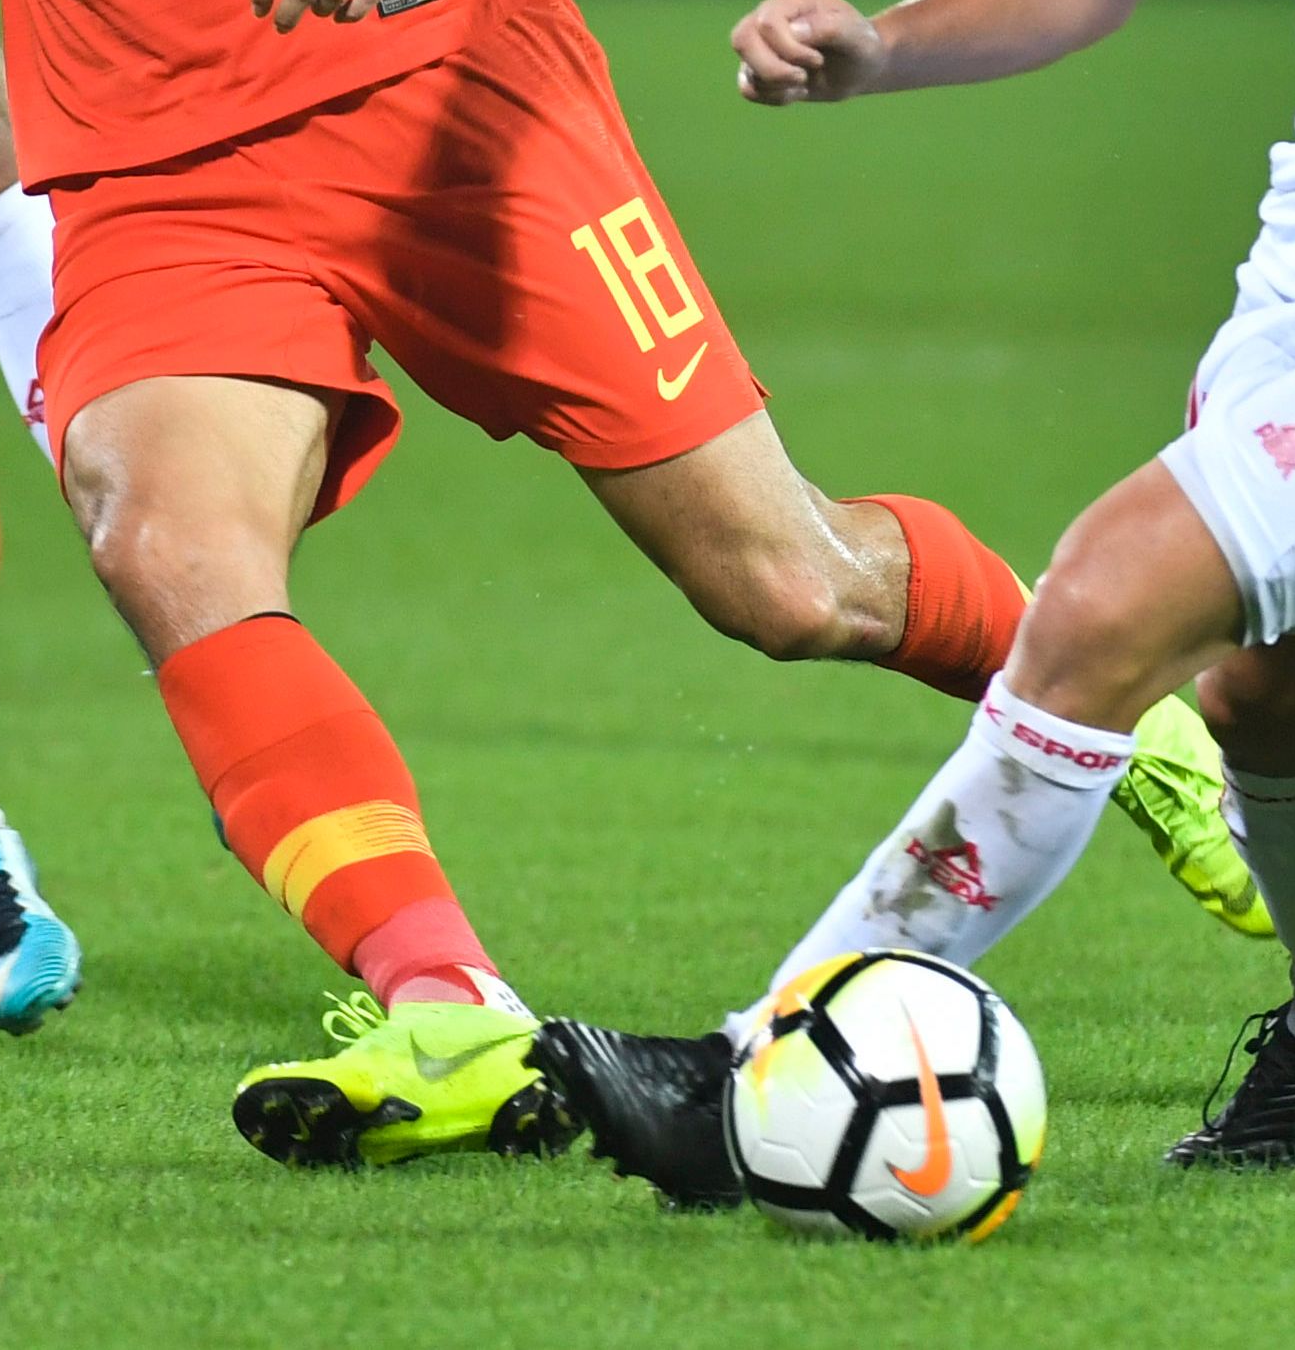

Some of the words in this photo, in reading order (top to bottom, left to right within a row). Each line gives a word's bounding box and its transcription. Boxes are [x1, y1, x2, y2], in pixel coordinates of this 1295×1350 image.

[570, 196, 705, 353] 18
[1011, 721, 1128, 770] SPOR
[905, 837, 1002, 912] PEAK
